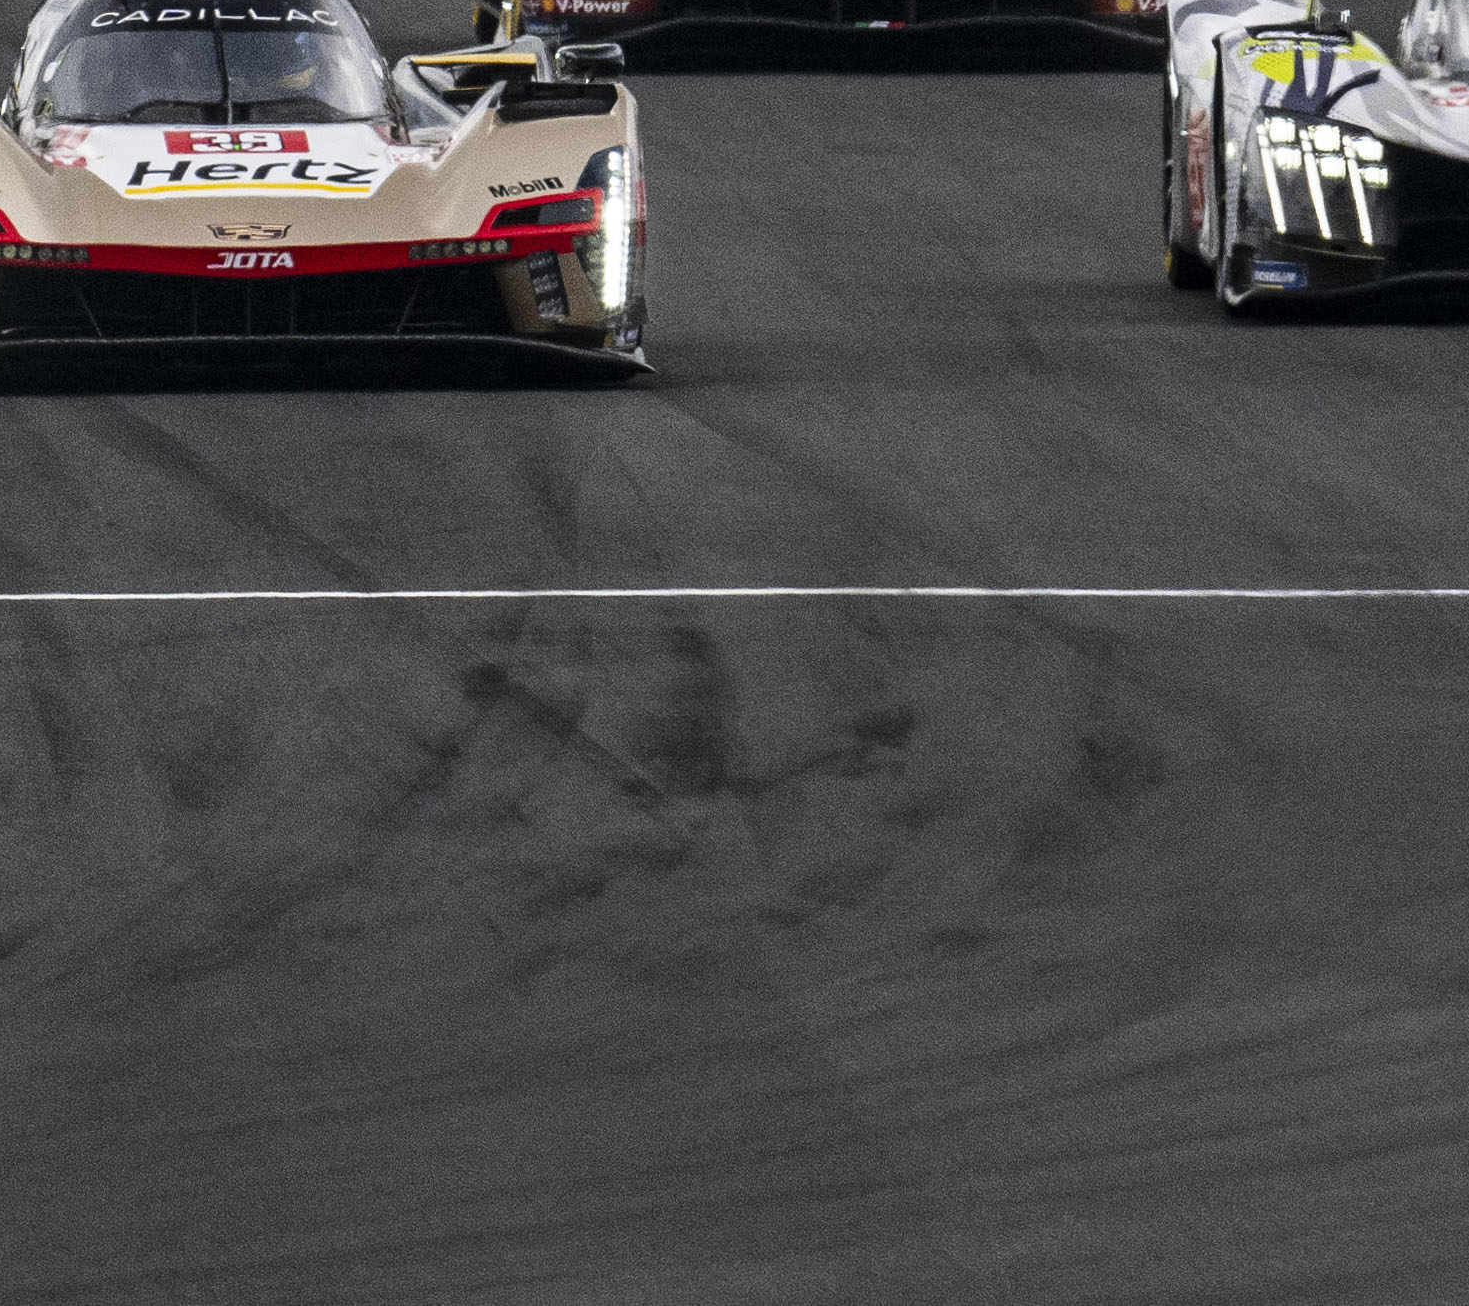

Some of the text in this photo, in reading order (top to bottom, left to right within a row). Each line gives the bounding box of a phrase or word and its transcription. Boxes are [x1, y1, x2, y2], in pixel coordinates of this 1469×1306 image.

[90, 8, 339, 27] CADILLAC
[126, 158, 380, 187] Hertz
[487, 177, 546, 199] Mobil
[206, 251, 295, 270] JOTA
